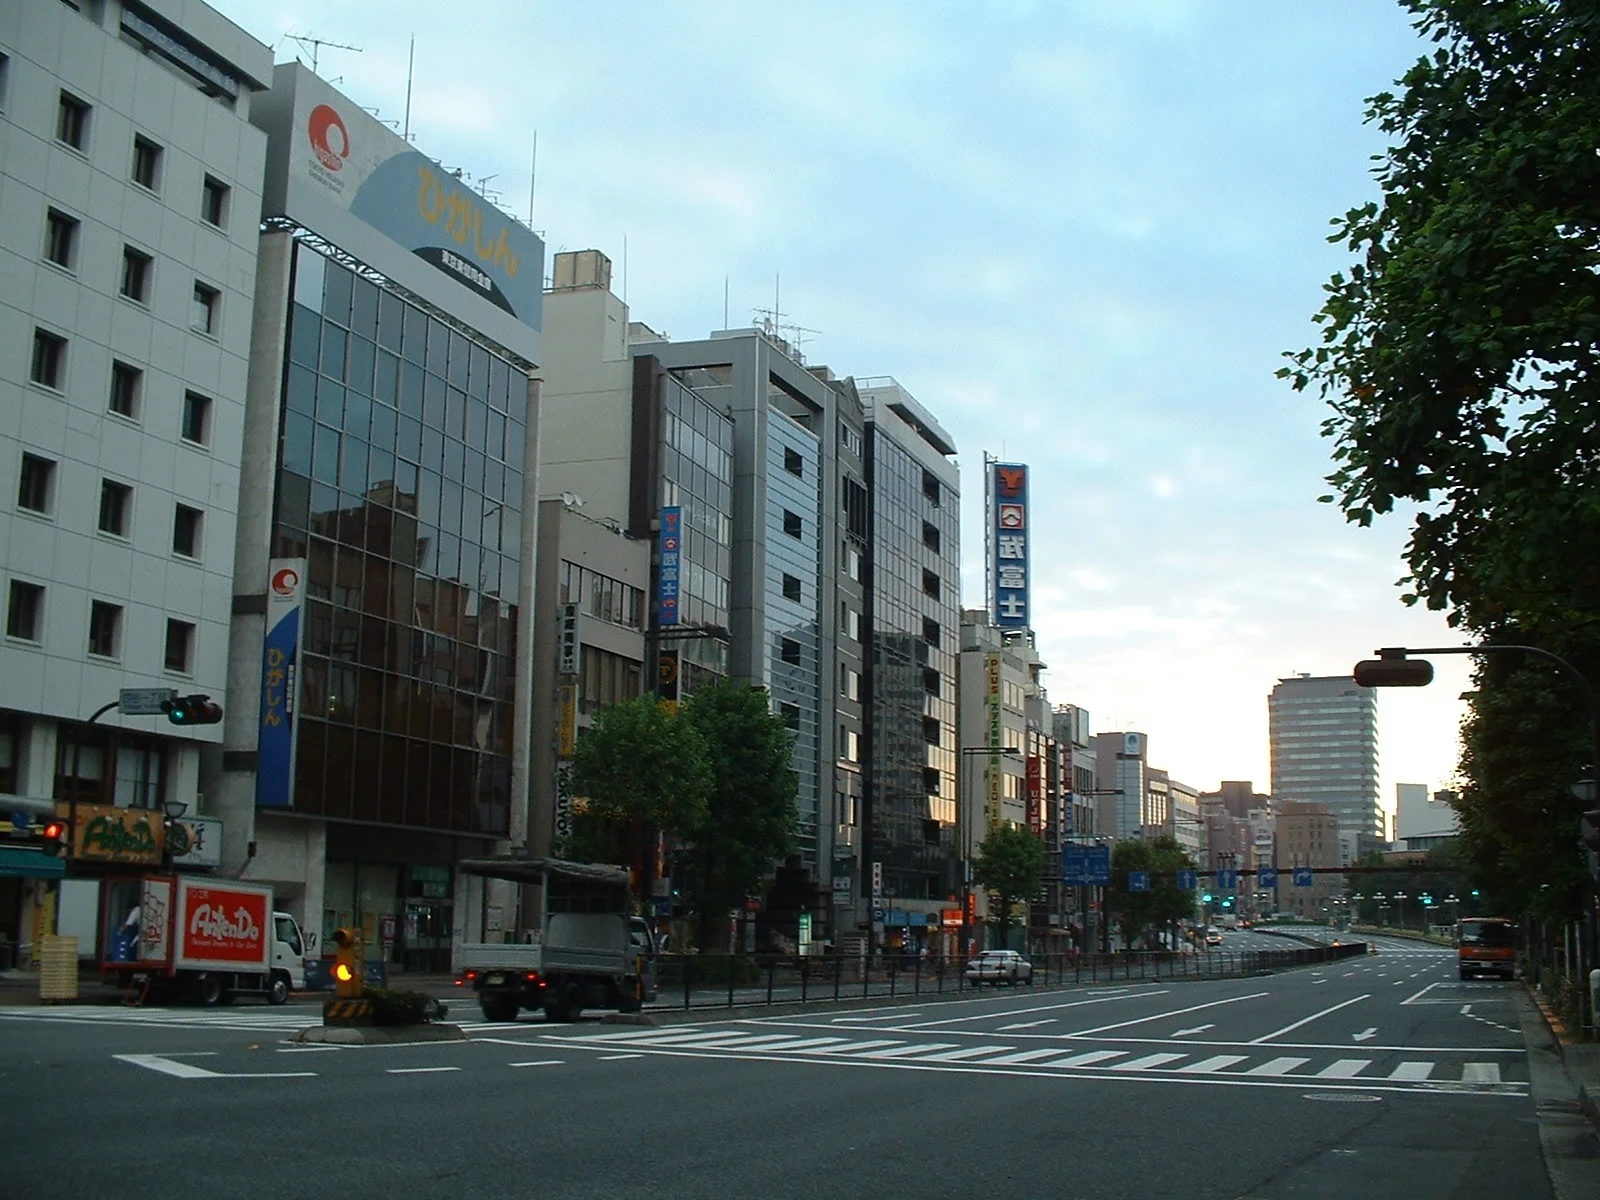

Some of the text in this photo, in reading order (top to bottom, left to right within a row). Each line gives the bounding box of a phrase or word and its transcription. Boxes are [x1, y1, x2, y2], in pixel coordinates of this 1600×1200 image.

[418, 165, 520, 277] ひがしん
[662, 552, 678, 596] 武富士
[999, 534, 1025, 618] 武富士
[264, 647, 285, 728] ひがしん
[990, 659, 999, 694] PLUS
[190, 903, 259, 942] AntenDo
